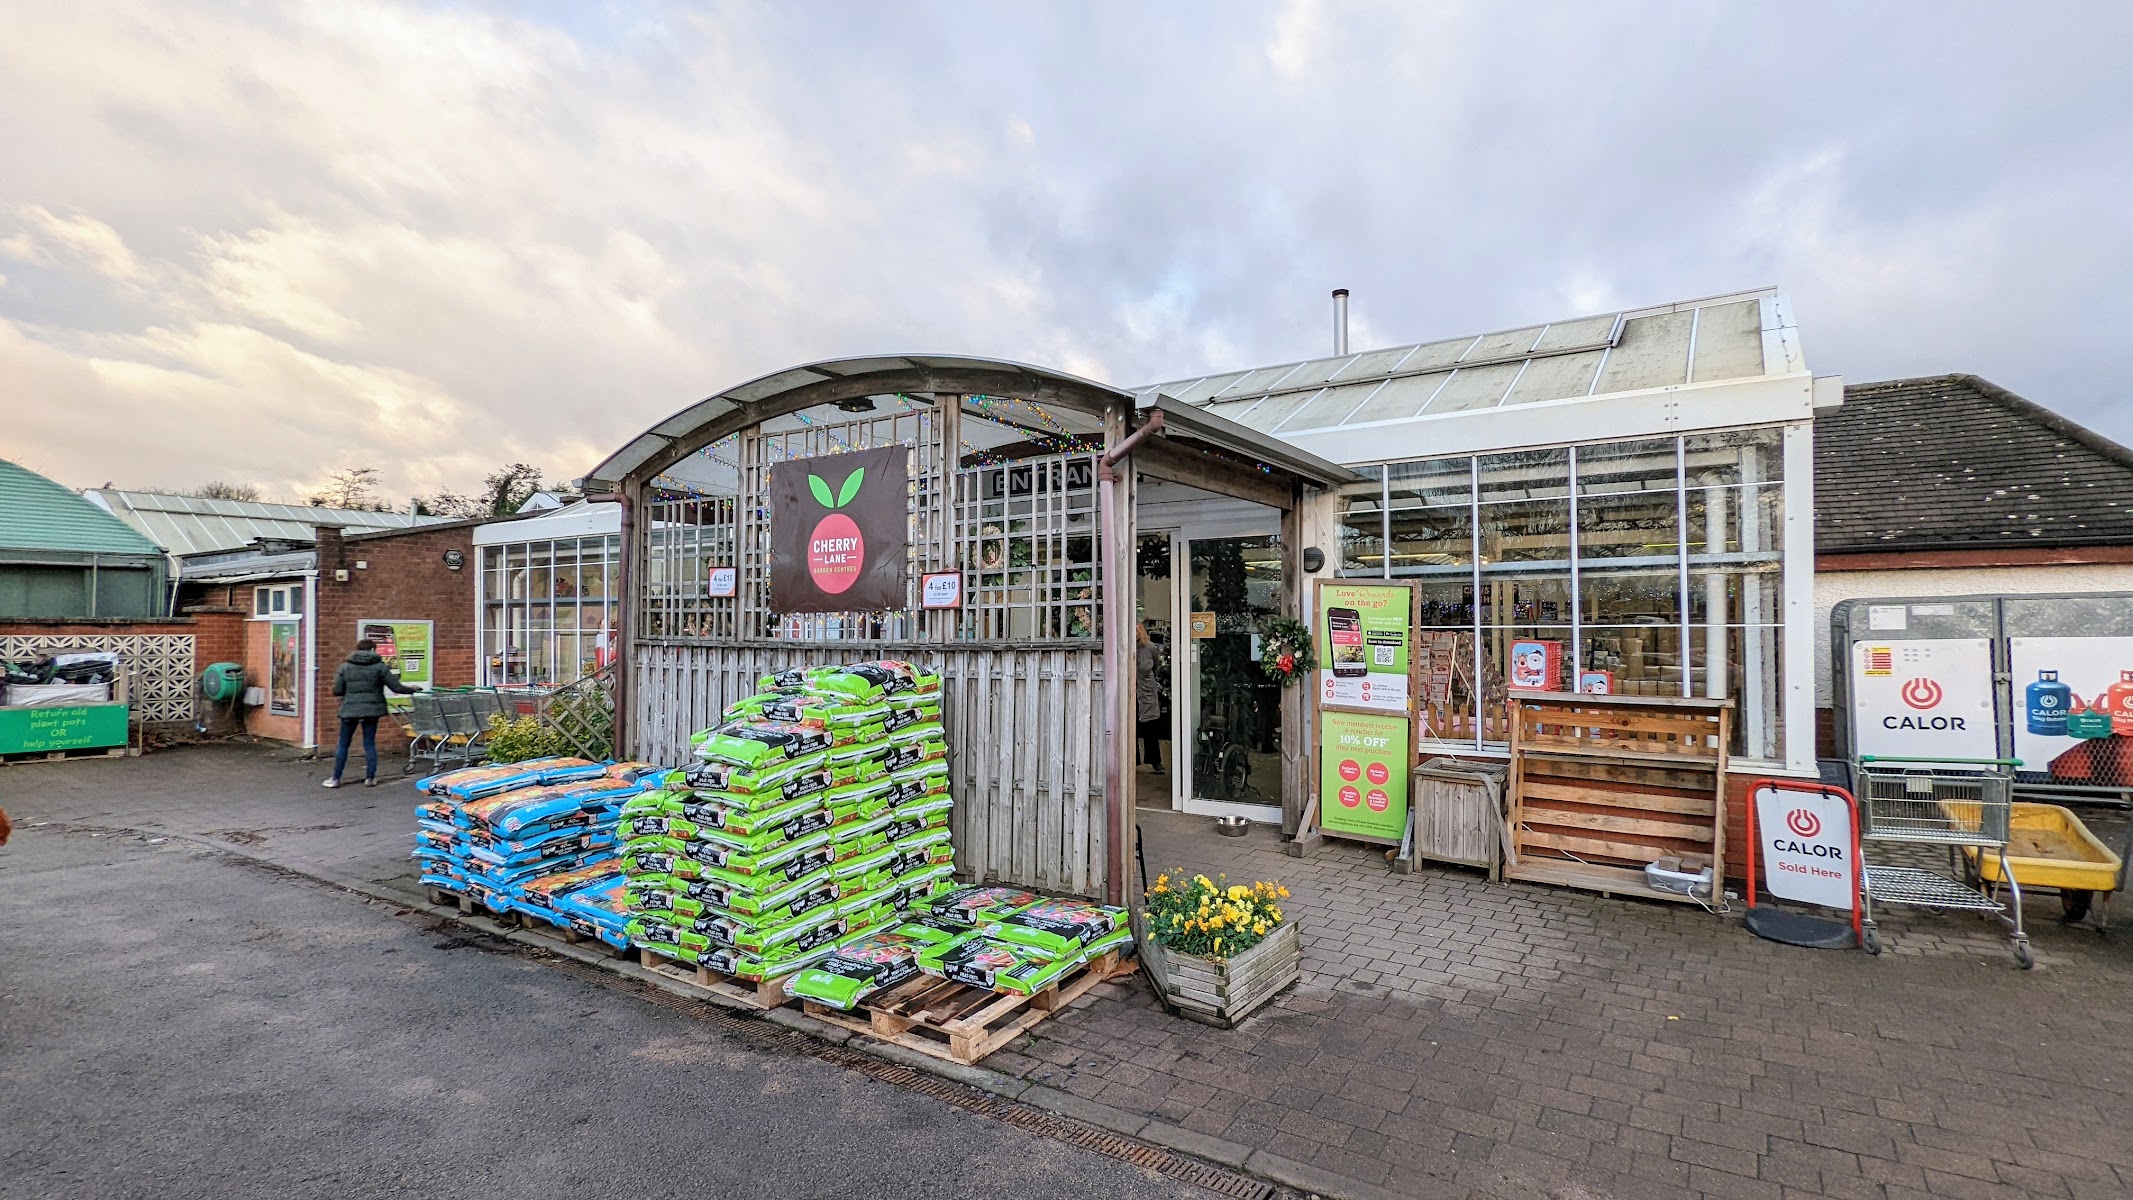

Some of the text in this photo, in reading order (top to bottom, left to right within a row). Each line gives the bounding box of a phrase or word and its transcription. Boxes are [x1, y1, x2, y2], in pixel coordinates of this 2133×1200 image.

[813, 537, 858, 553] CHERRY
[824, 553, 847, 565] LANE
[833, 565, 857, 573] CENTRES
[713, 574, 718, 582] 4
[928, 582, 934, 591] 4
[942, 581, 956, 590] £10
[1336, 587, 1395, 599] Love Rewards
[1357, 599, 1371, 607] the
[1372, 599, 1388, 609] go?
[30, 707, 88, 719] Return old
[2031, 708, 2067, 717] CALOR
[2113, 710, 2133, 718] CAL
[30, 718, 86, 729] plant pots
[1347, 720, 1376, 729] members
[1376, 722, 1398, 731] receive
[1882, 715, 1967, 731] CALOR
[50, 728, 67, 737] OR
[1350, 728, 1374, 736] voucher
[1374, 729, 1384, 737] for
[23, 735, 92, 748] help yourself
[1340, 734, 1361, 746] 10%
[1365, 747, 1393, 756] purchase
[1773, 839, 1843, 860] CALOR
[1778, 861, 1842, 879] Sold Here
